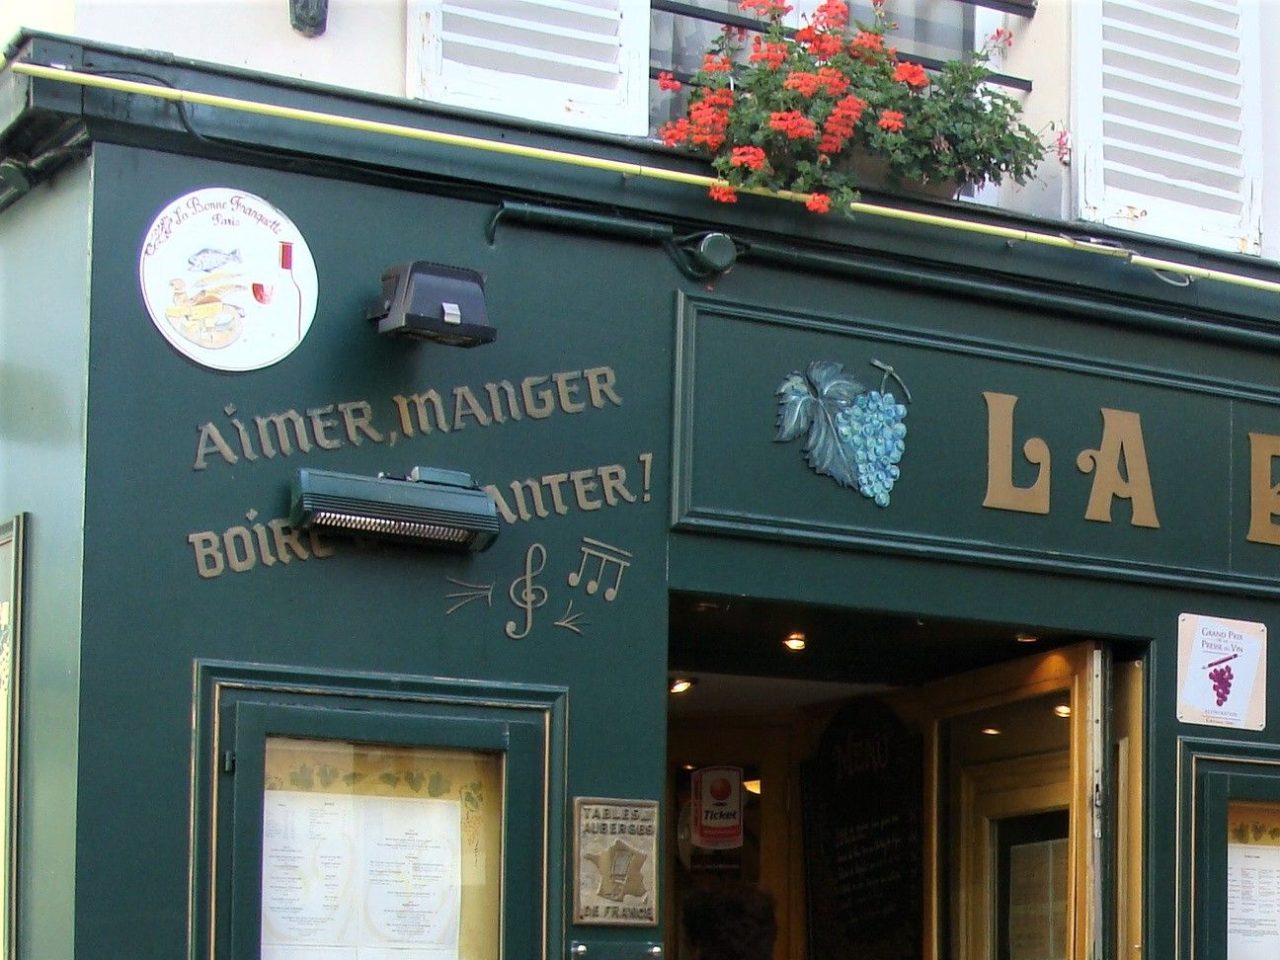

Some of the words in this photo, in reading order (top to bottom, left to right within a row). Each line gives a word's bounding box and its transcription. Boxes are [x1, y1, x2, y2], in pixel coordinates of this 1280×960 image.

[186, 196, 228, 216] Bonne
[981, 390, 1161, 529] LA
[583, 807, 640, 821] TABLES
[583, 822, 656, 836] AUBERGES
[583, 905, 600, 917] DE
[603, 906, 653, 919] FRANCE
